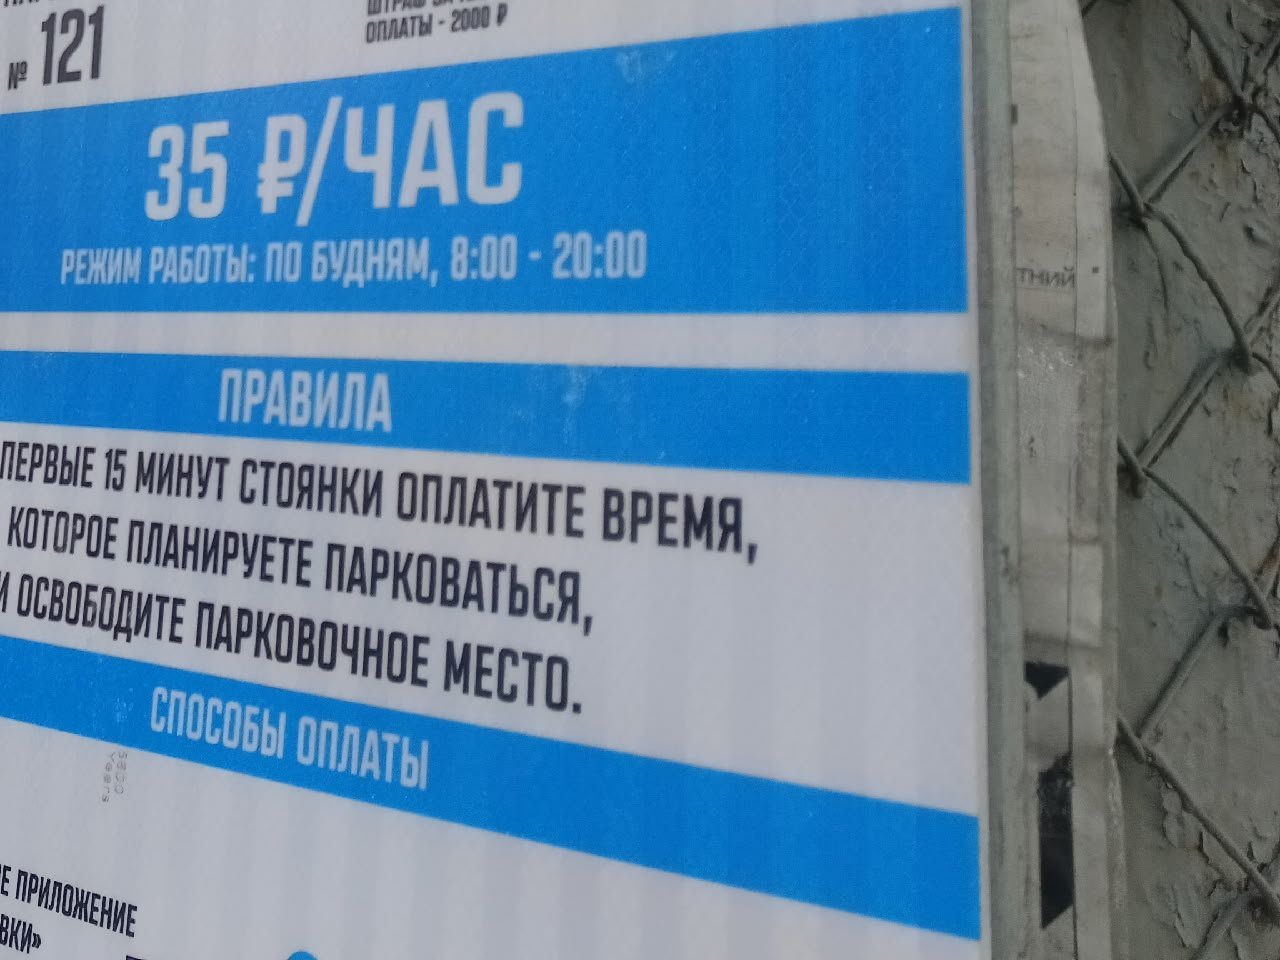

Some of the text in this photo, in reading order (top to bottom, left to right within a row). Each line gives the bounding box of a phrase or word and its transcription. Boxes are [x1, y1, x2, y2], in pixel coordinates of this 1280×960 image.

[41, 5, 105, 86] 121
[365, 13, 433, 44] ОПЛАТЫ
[450, 5, 491, 33] 2000
[145, 120, 230, 221] 35
[60, 247, 142, 285] РЕЖИМ
[148, 243, 257, 284] РАБОТЫ:
[265, 240, 303, 283] ПО
[311, 237, 438, 288] БУДНЯМ,
[450, 234, 518, 281] 8:00
[552, 229, 647, 280] 20:00
[219, 368, 392, 433] ПРАВИЛА
[104, 448, 128, 492] 15
[135, 451, 230, 502] МИНУТ
[239, 458, 384, 518] СТОЯНКИ
[396, 471, 586, 539] ОПЛАТИТЕ
[602, 487, 758, 564] ВРЕМЯ,
[7, 505, 119, 560] КОТОРОЕ
[126, 519, 314, 588] ПЛАНИРУЕТЕ
[324, 542, 593, 636] ПАРКОВАТЬСЯ,
[16, 573, 187, 644] ОСВОБОДИТЕ
[195, 601, 430, 688] ПАРКОВОЧНОЕ
[443, 639, 582, 714] МЕСТО.
[150, 686, 429, 790] СПОСОБЫ ОПЛАТЫ
[15, 870, 138, 938] ПРИЛОЖЕНИЕ
